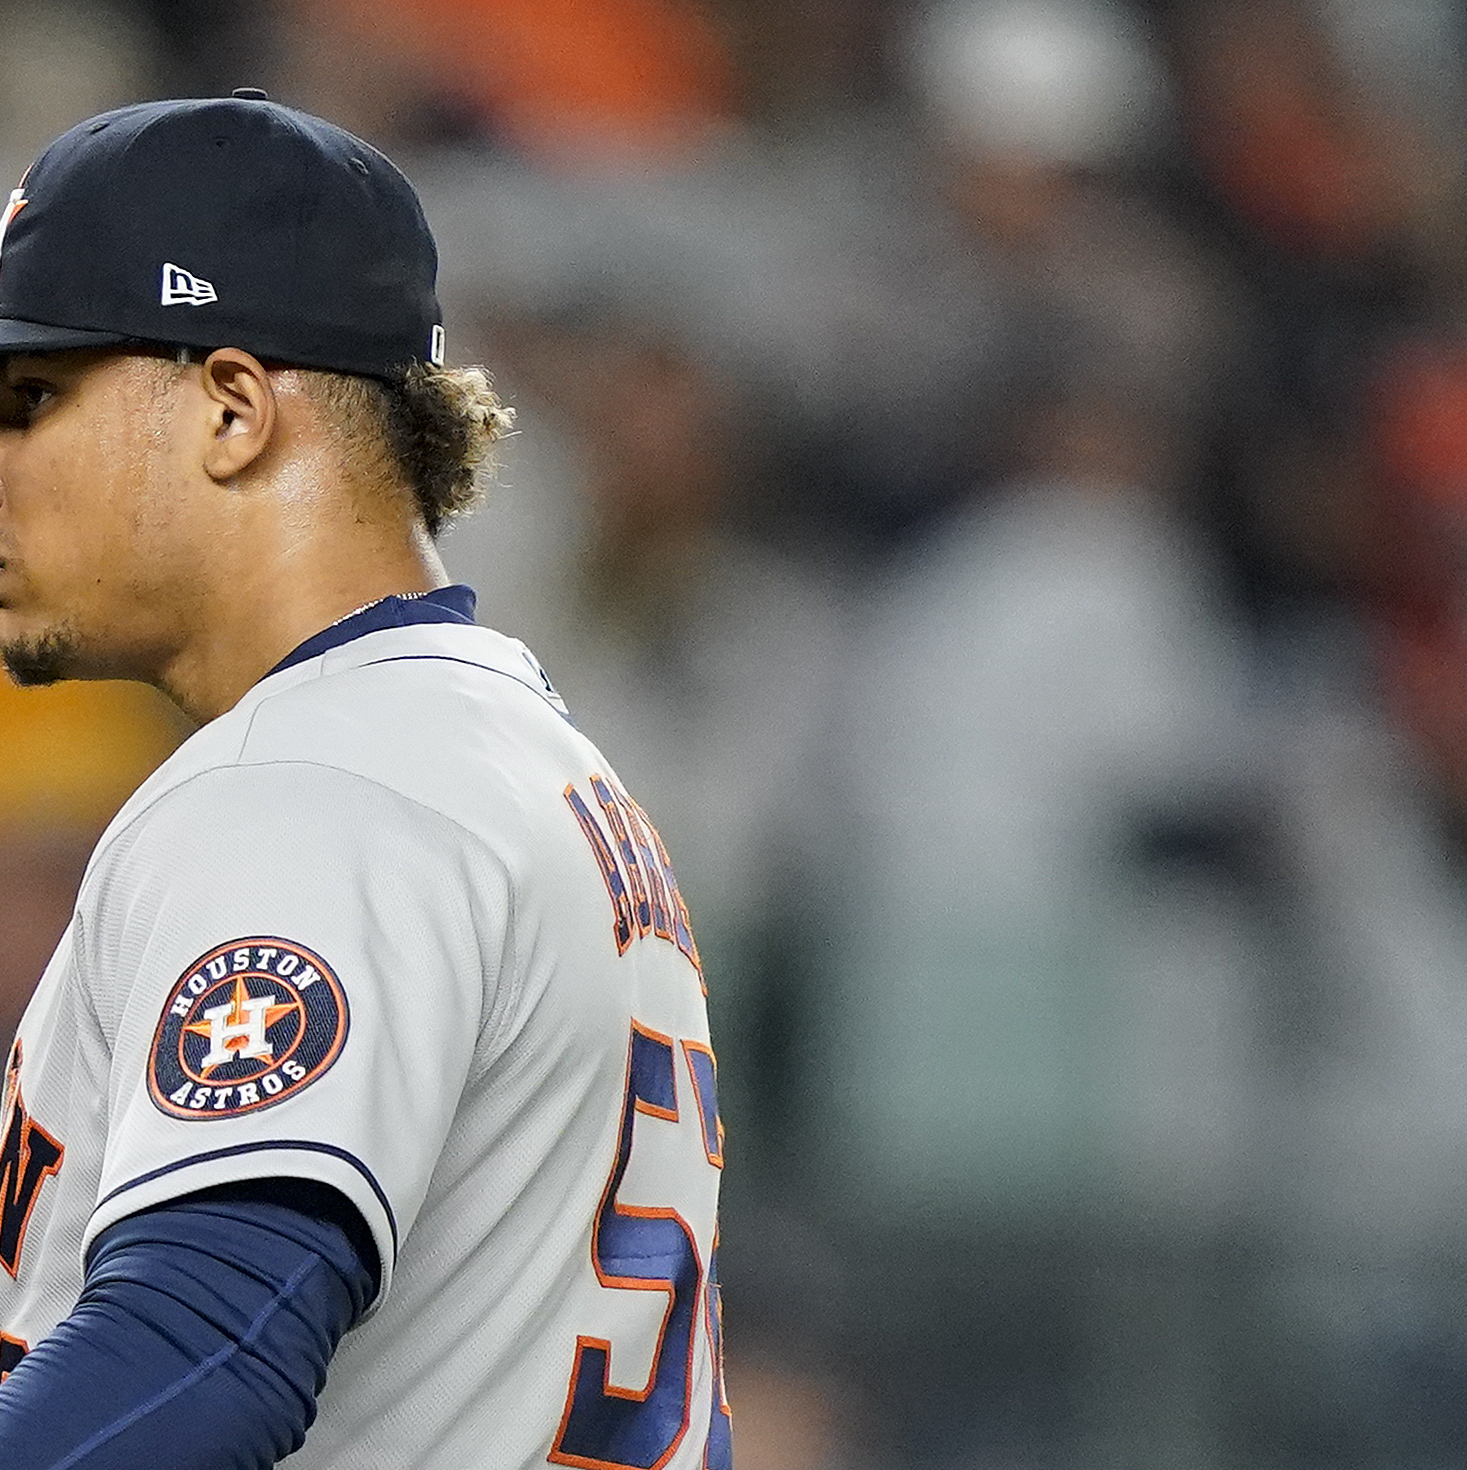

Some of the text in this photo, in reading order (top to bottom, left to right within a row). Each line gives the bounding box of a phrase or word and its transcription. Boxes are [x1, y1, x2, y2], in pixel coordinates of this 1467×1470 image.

[171, 948, 321, 1017] HOUSTON
[201, 995, 276, 1068] H
[170, 1060, 306, 1109] ASTROS
